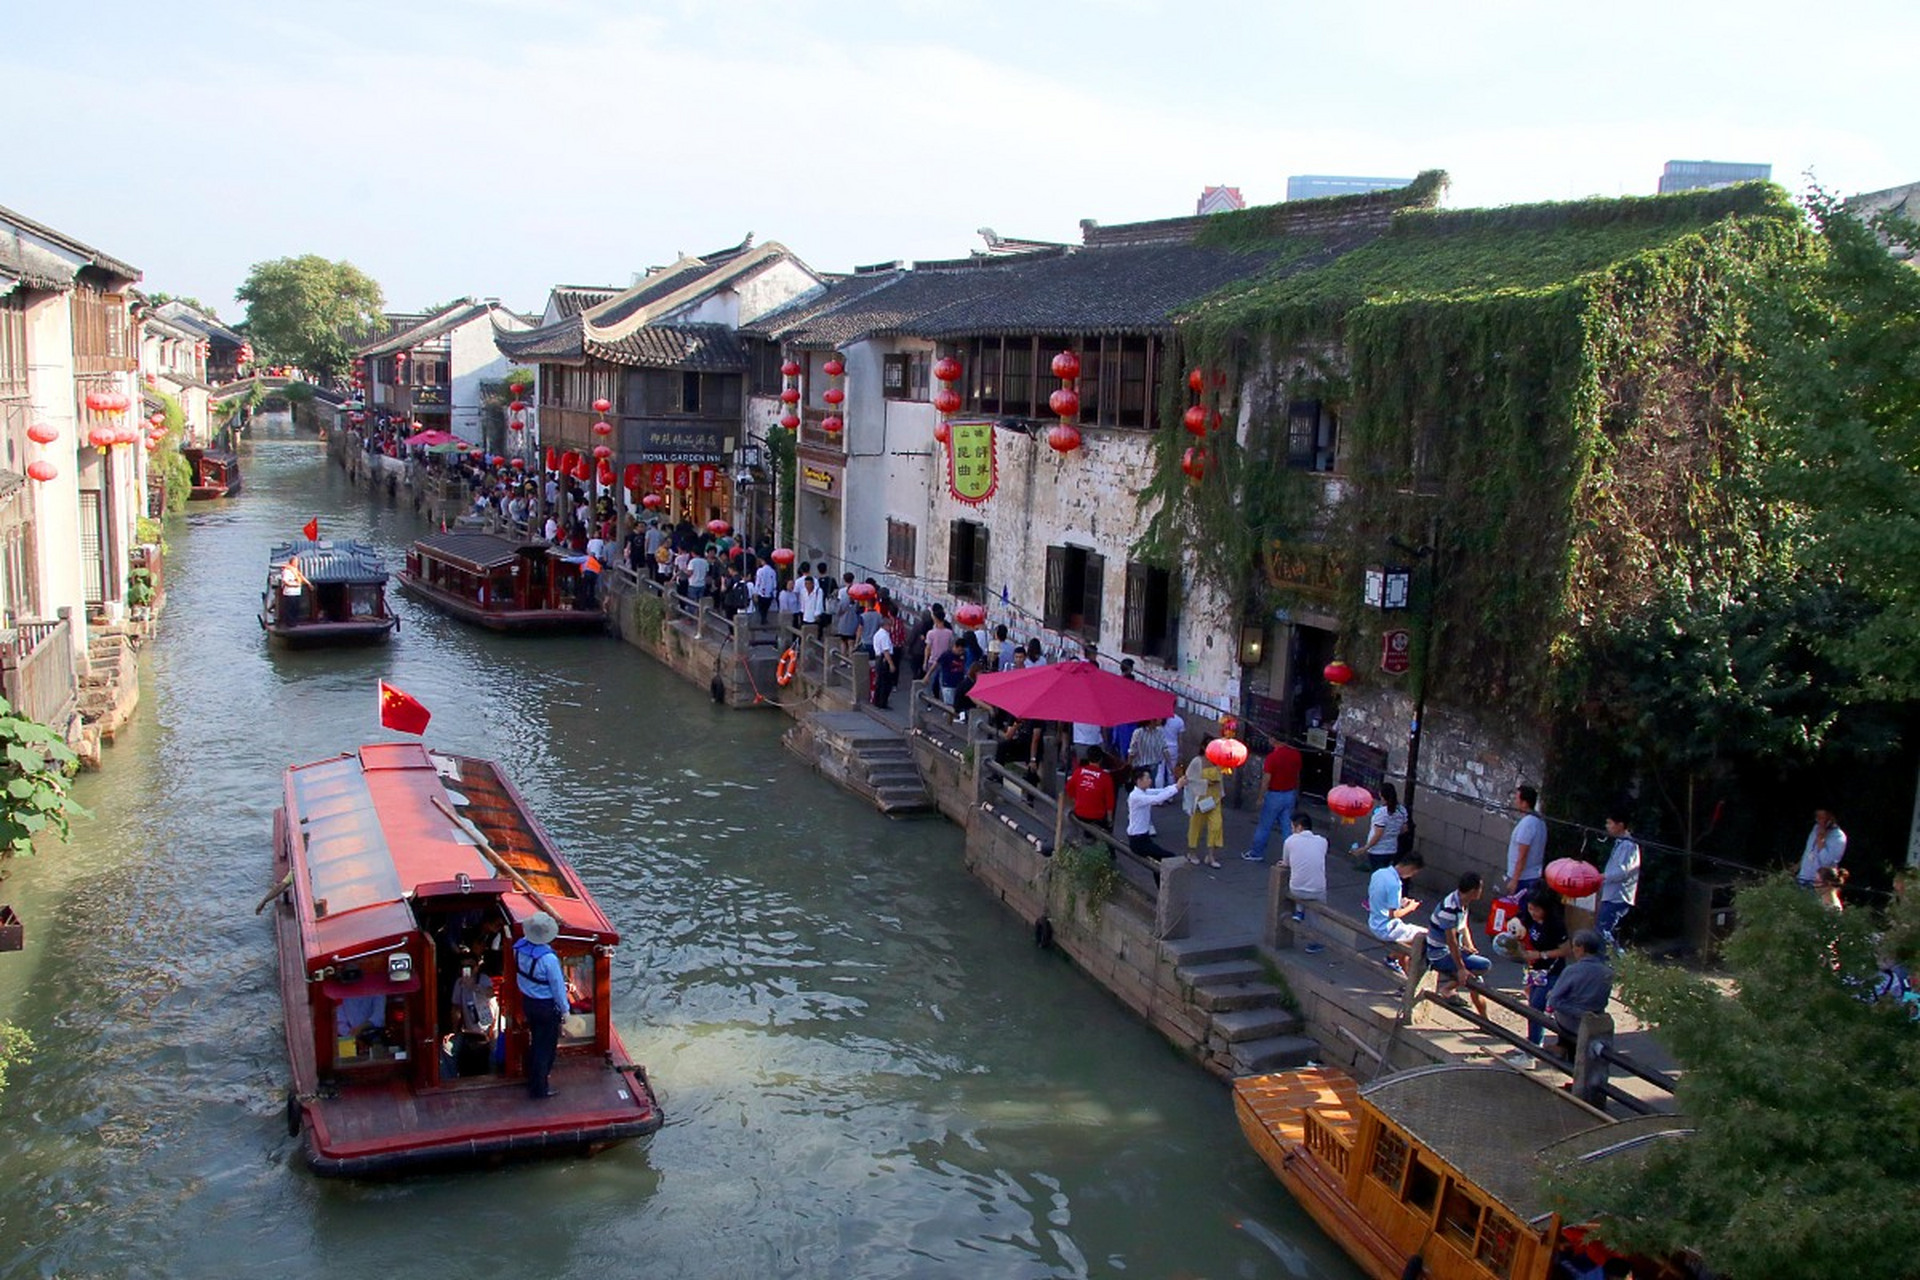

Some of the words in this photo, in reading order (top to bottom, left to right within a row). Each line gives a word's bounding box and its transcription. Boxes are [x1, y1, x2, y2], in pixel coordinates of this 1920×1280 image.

[643, 453, 668, 462] ROYAL
[670, 453, 705, 462] GARDEN
[706, 454, 721, 462] INN
